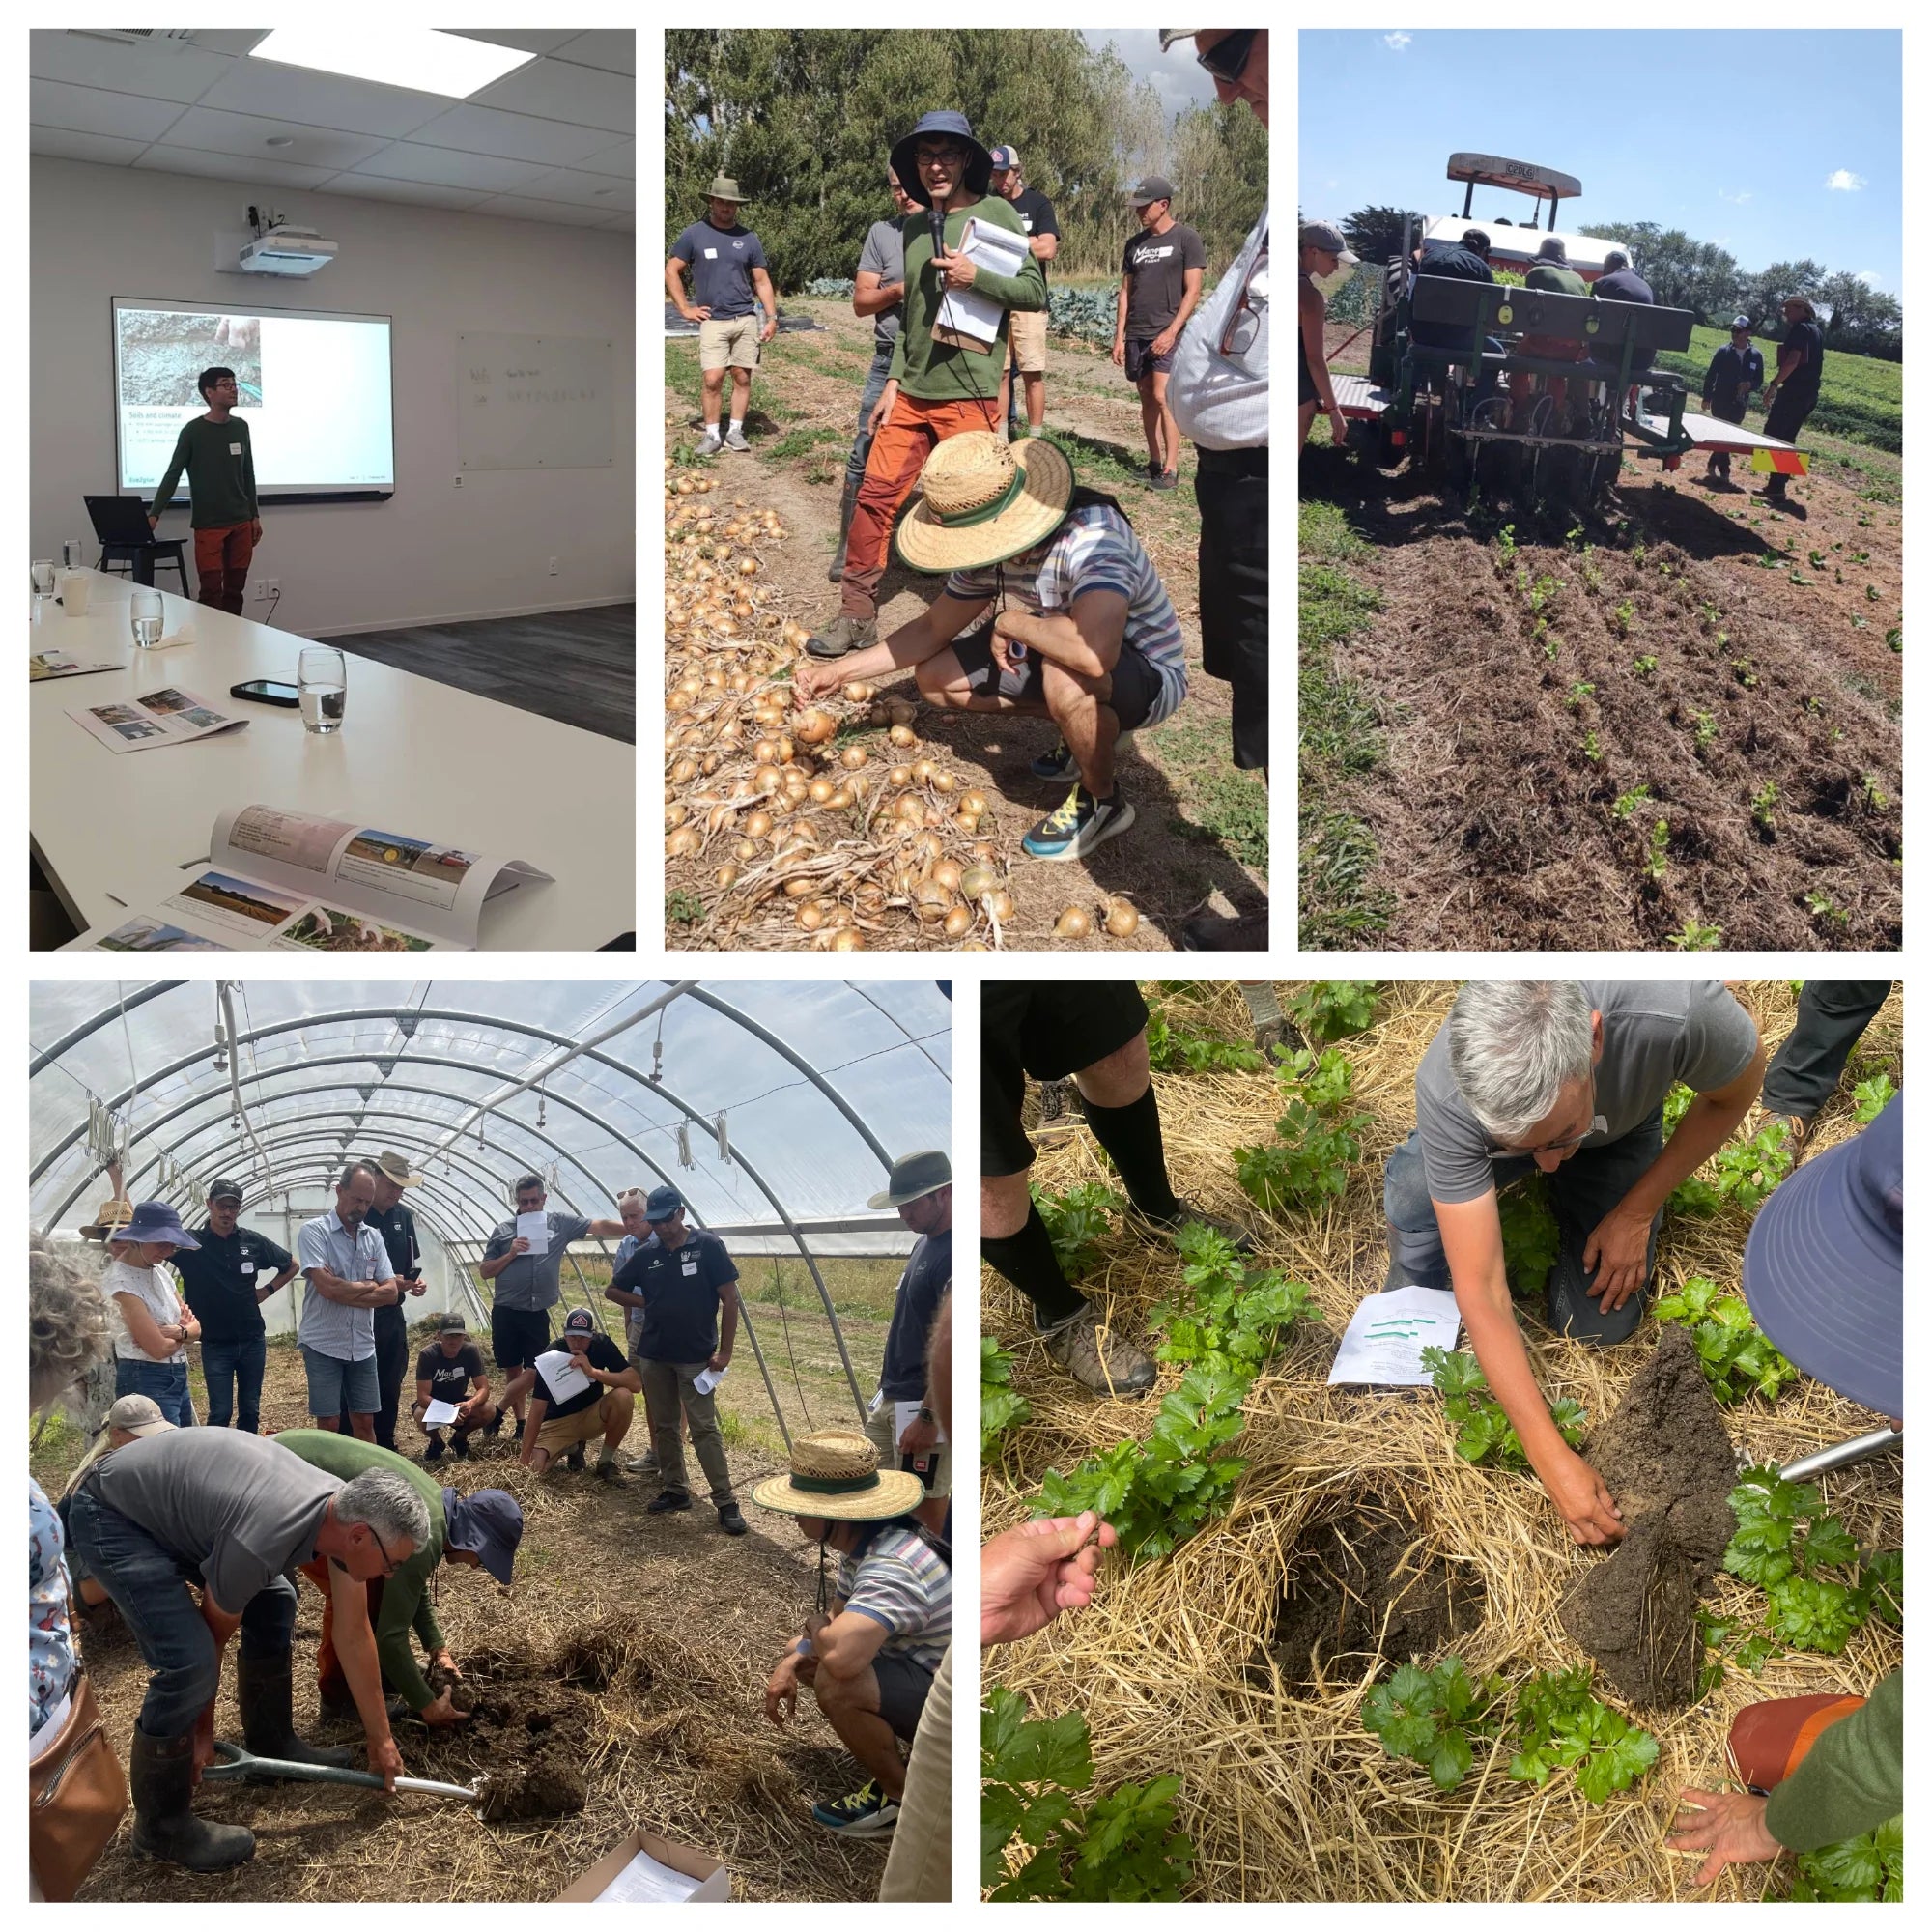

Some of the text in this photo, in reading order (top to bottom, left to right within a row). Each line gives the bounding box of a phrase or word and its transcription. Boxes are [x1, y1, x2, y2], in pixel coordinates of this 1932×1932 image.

[128, 411, 182, 419] Soils and climate
